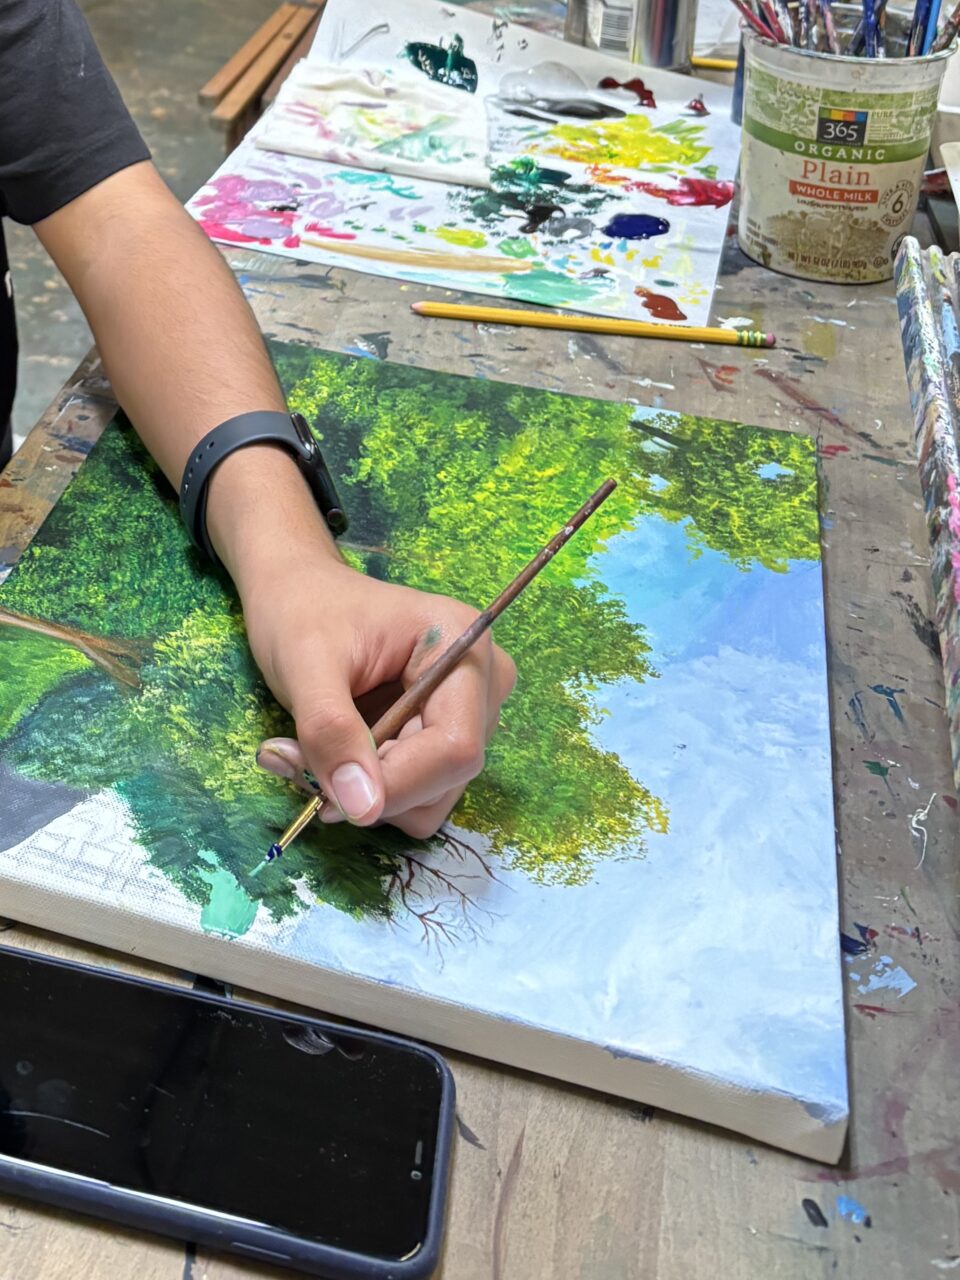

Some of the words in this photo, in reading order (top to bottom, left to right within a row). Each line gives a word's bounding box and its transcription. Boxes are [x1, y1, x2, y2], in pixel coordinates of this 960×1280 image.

[823, 121, 858, 141] 365
[794, 140, 886, 160] ORGANIC
[800, 159, 871, 186] Plain
[796, 183, 840, 200] WHOLE
[843, 190, 872, 201] MILK
[891, 192, 904, 214] 6
